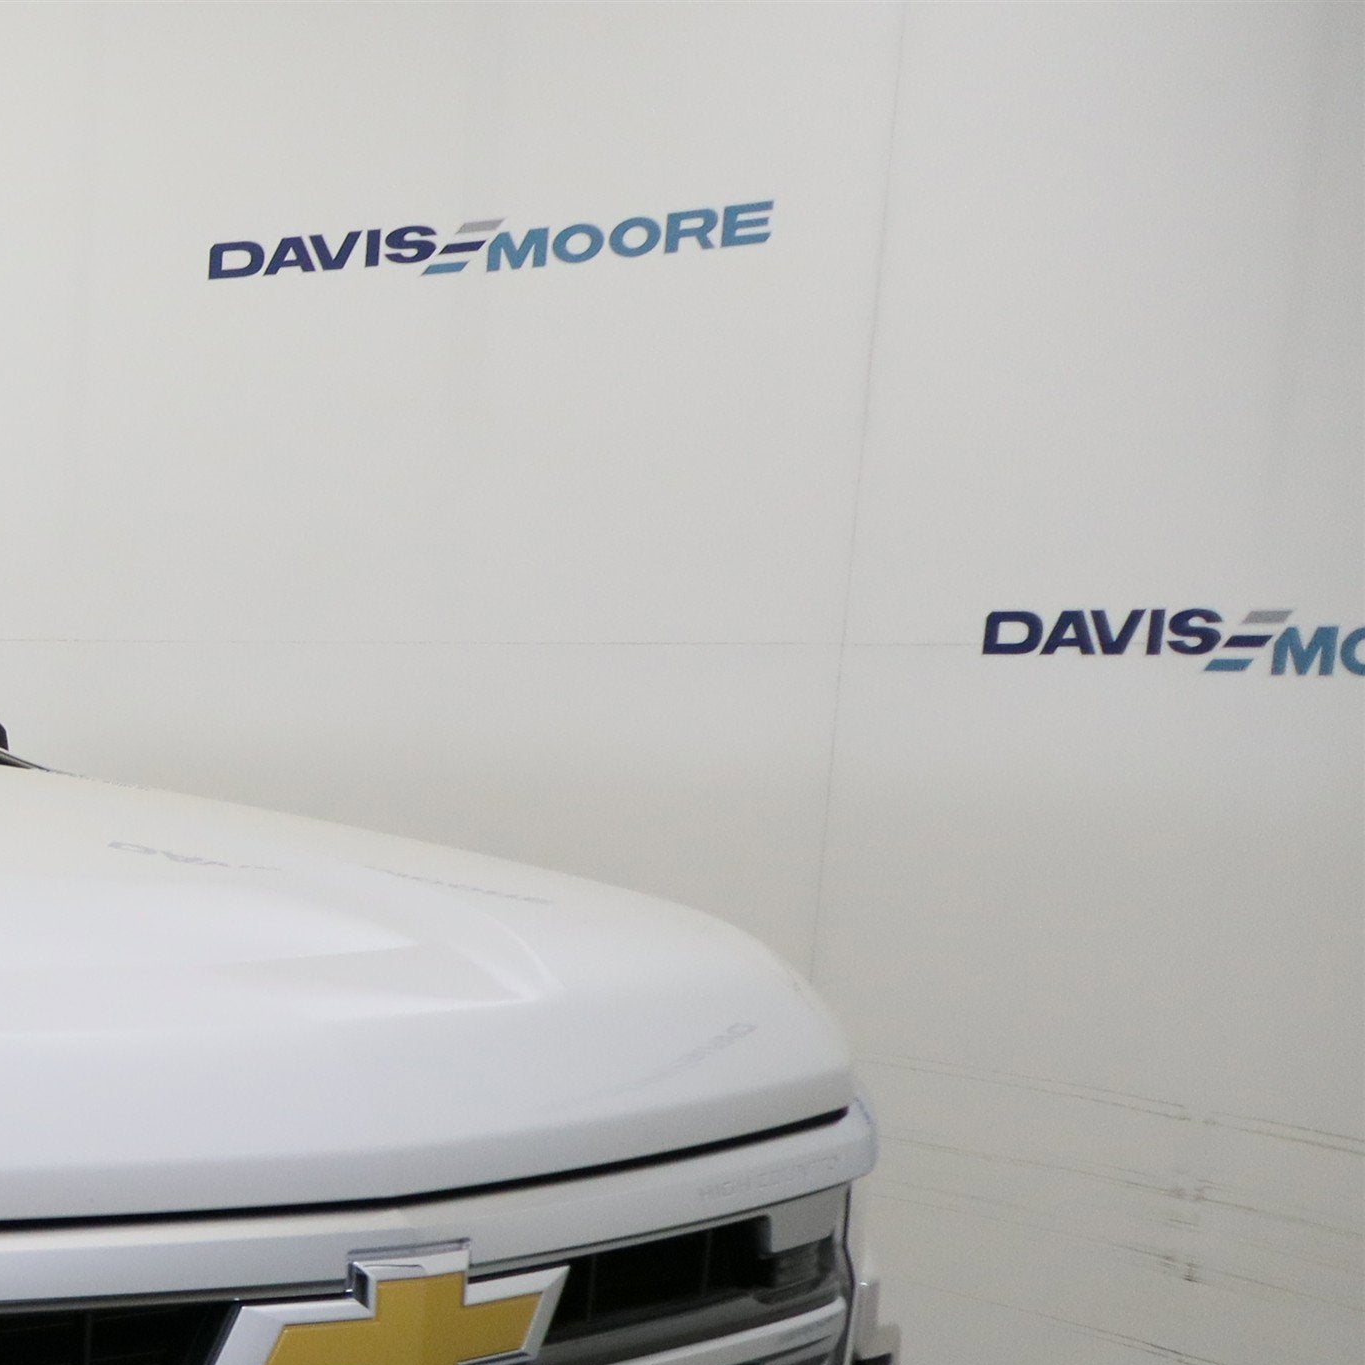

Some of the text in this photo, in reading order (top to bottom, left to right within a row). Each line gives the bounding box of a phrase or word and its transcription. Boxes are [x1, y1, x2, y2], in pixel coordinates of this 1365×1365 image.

[208, 200, 774, 281] DAVIS MOORE
[982, 607, 1223, 656] DAVIS
